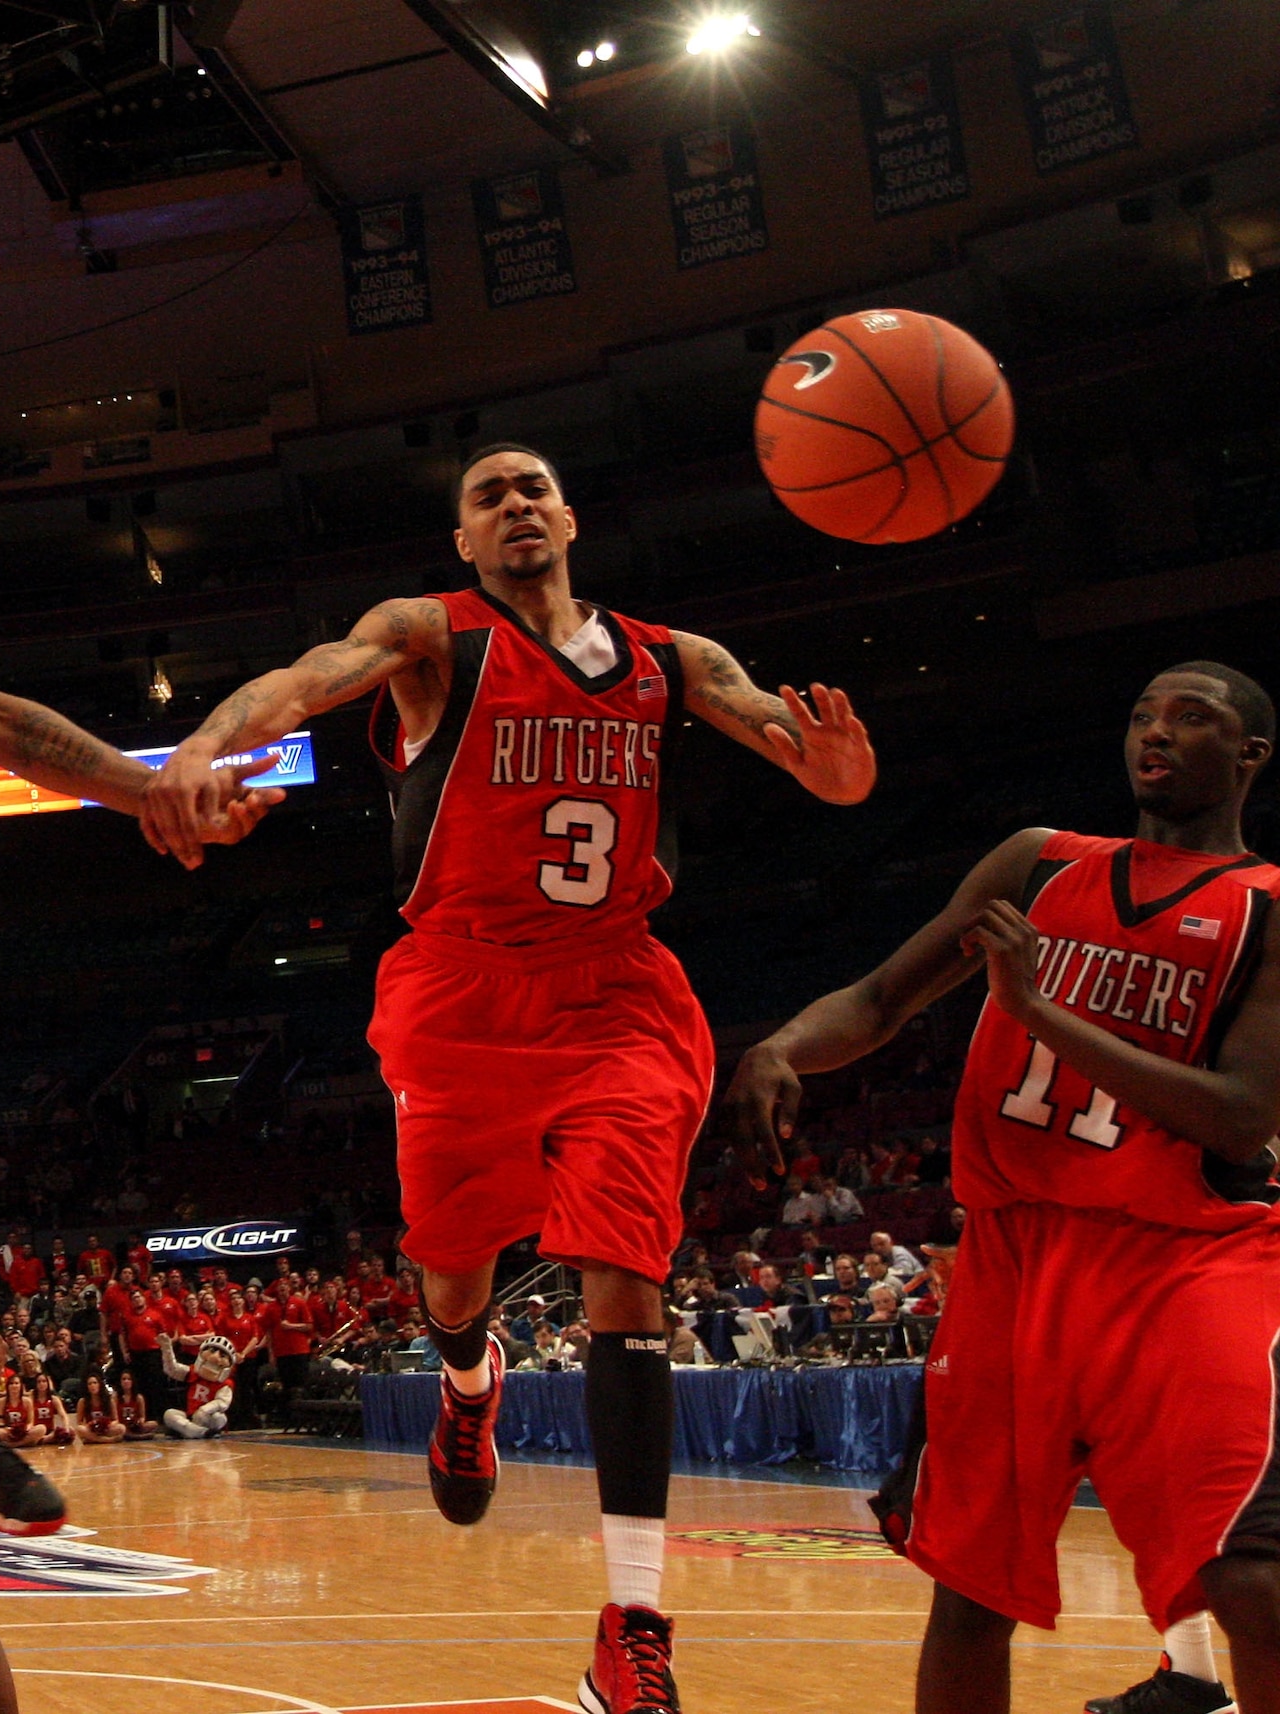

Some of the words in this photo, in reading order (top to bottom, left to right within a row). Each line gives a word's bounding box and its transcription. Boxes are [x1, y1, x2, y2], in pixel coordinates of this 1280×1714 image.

[1037, 123, 1135, 169] CHAMPIONS
[875, 174, 966, 213] CHAMPIONS
[684, 194, 751, 225] REGULAR
[689, 216, 751, 243] SEASON
[495, 239, 558, 265] ATLANTIC
[680, 230, 765, 266] CHAMPIONS
[360, 269, 415, 292] EASTERN
[499, 260, 557, 283] DIVISION
[350, 284, 428, 312] CONFERENCE
[492, 273, 577, 304] CHAMPIONS
[355, 305, 425, 328] CHAMPIONS
[491, 717, 661, 789] RUTGERS
[536, 795, 619, 909] 3
[145, 1236, 202, 1252] BUD
[216, 1228, 298, 1247] LIGHT
[192, 1383, 211, 1402] R
[37, 1407, 51, 1419] R
